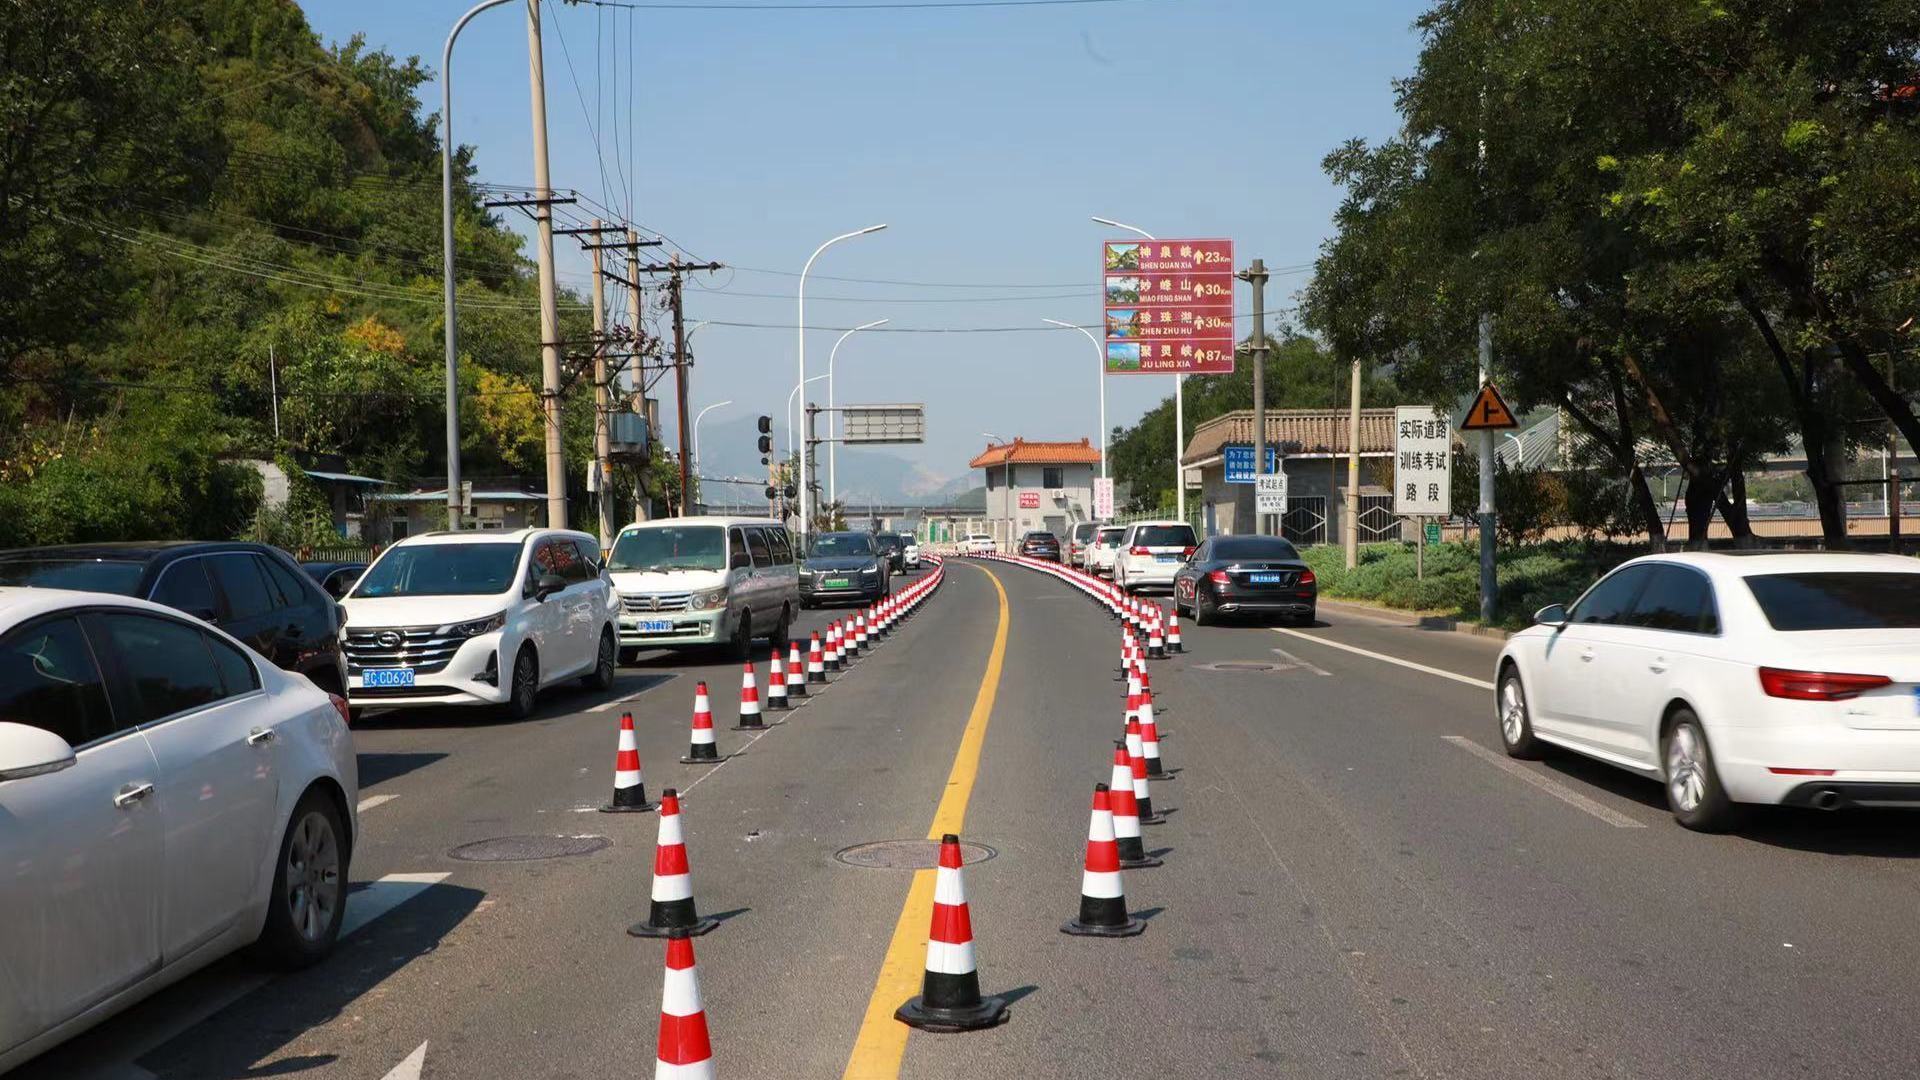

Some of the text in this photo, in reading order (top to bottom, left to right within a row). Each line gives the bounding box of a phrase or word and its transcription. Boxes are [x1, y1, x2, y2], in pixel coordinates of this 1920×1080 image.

[1140, 246, 1192, 258] 神泉峡
[1140, 278, 1192, 292] 妙峰山
[1140, 311, 1192, 324] 珍珠湖
[1177, 360, 1191, 368] XIA
[1400, 420, 1447, 439] 实际道路
[1400, 451, 1446, 471] 训练考试
[1406, 483, 1439, 501] 路段
